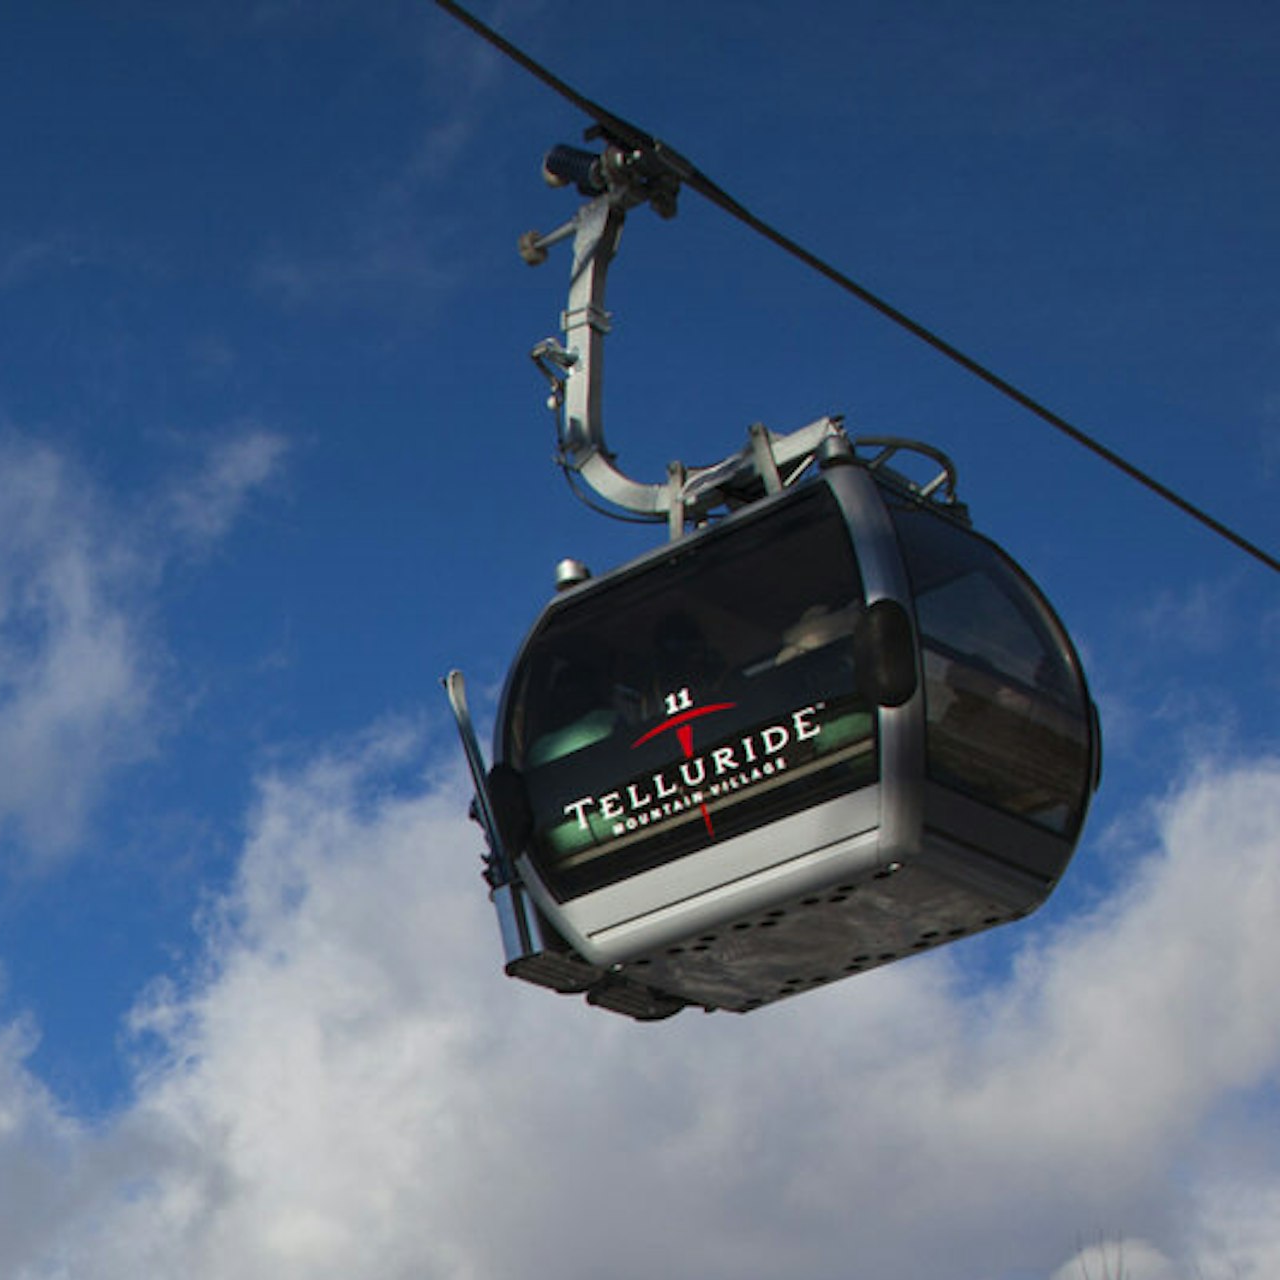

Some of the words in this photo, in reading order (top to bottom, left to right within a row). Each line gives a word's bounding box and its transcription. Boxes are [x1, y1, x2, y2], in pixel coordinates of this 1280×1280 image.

[563, 706, 821, 830] TELLURIDE
[612, 791, 704, 836] MOUNTAIN
[709, 757, 787, 796] VILLAGE
